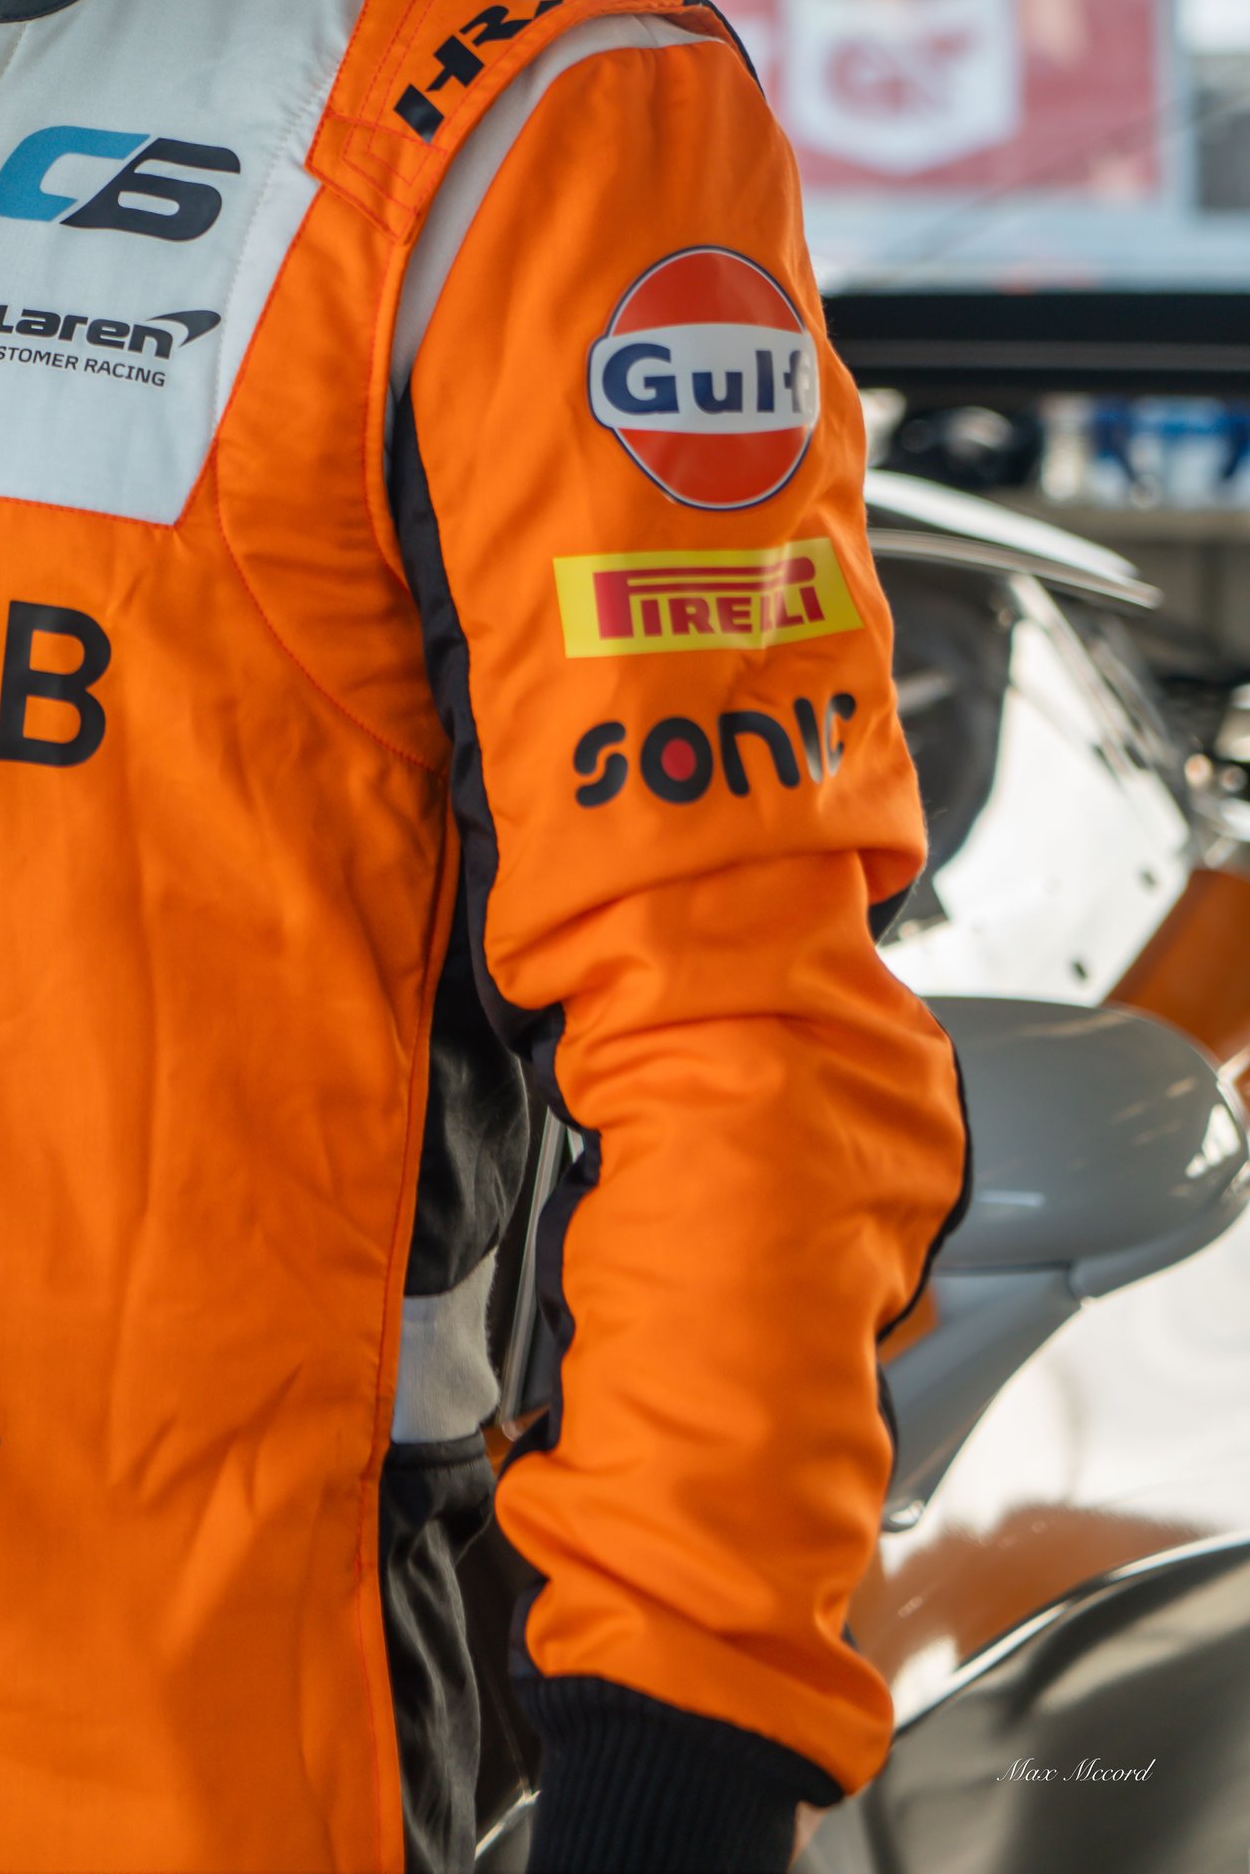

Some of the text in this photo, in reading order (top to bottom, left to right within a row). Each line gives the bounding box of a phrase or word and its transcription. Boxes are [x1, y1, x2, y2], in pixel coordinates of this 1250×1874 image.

[84, 357, 167, 388] RACING
[601, 342, 812, 415] Gulf
[592, 556, 826, 641] PIRELLI
